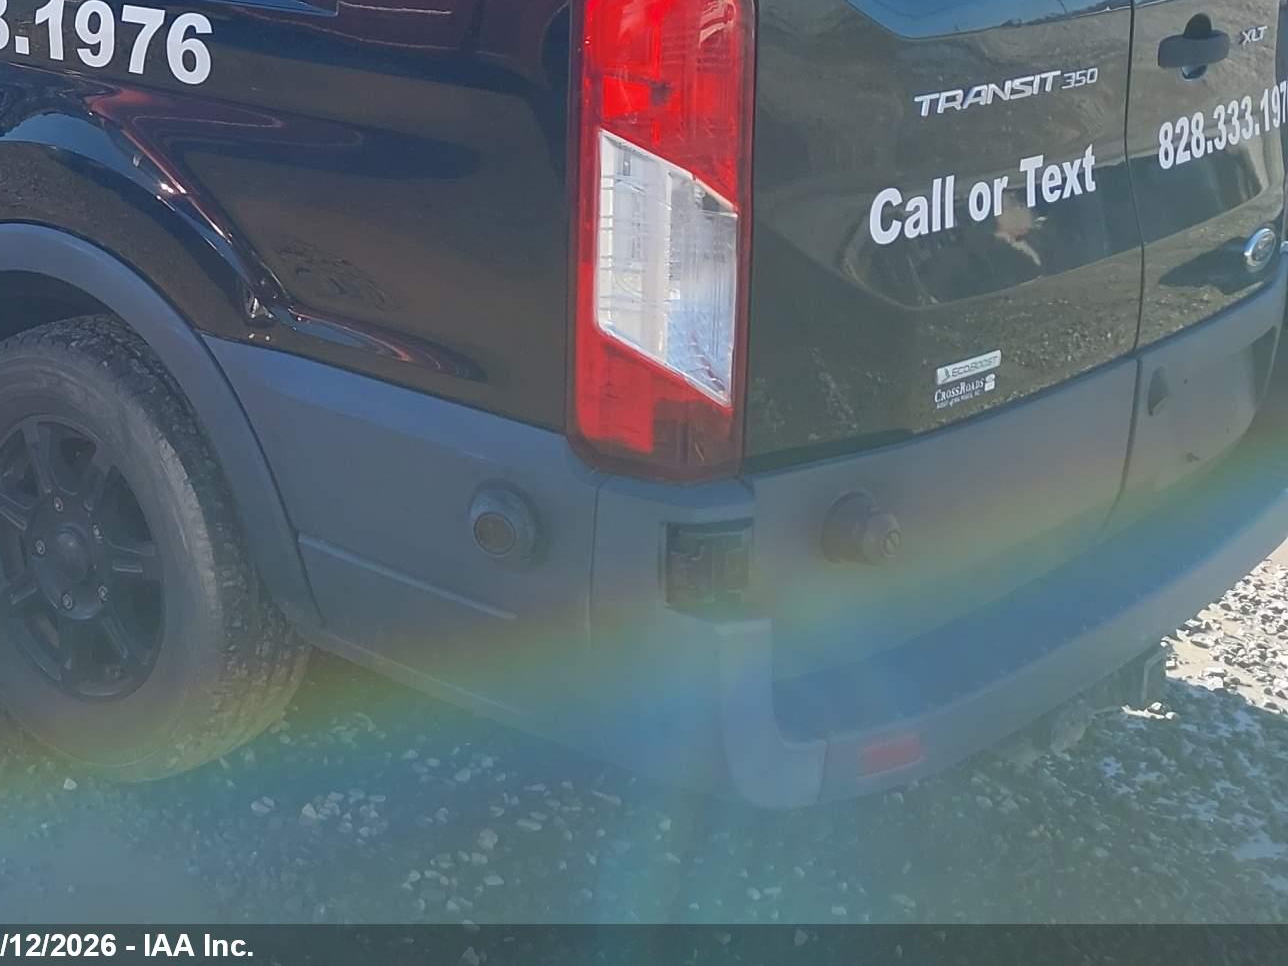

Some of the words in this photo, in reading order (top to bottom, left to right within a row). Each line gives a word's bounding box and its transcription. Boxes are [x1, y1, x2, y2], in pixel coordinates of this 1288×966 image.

[1242, 25, 1268, 46] XLT
[914, 70, 1062, 117] TRANSIT
[1062, 67, 1099, 90] 350
[868, 175, 956, 246] Call
[968, 174, 1009, 222] or
[1019, 143, 1097, 208] Text
[1158, 80, 1288, 170] 828.333.197
